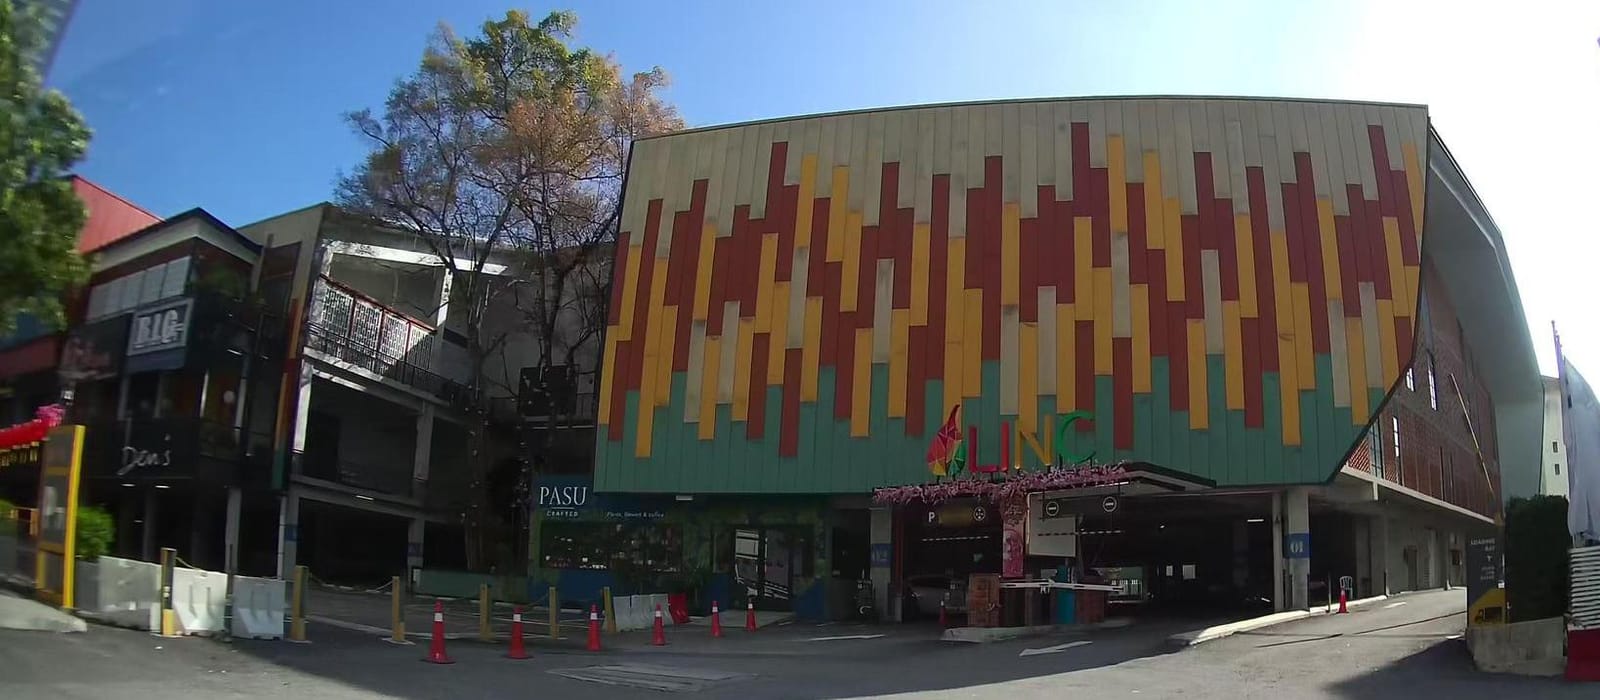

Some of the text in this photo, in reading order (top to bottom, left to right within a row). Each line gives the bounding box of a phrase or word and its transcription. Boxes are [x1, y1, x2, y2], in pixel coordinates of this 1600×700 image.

[971, 411, 1095, 472] LINC
[538, 486, 588, 506] PASU
[928, 511, 936, 523] P
